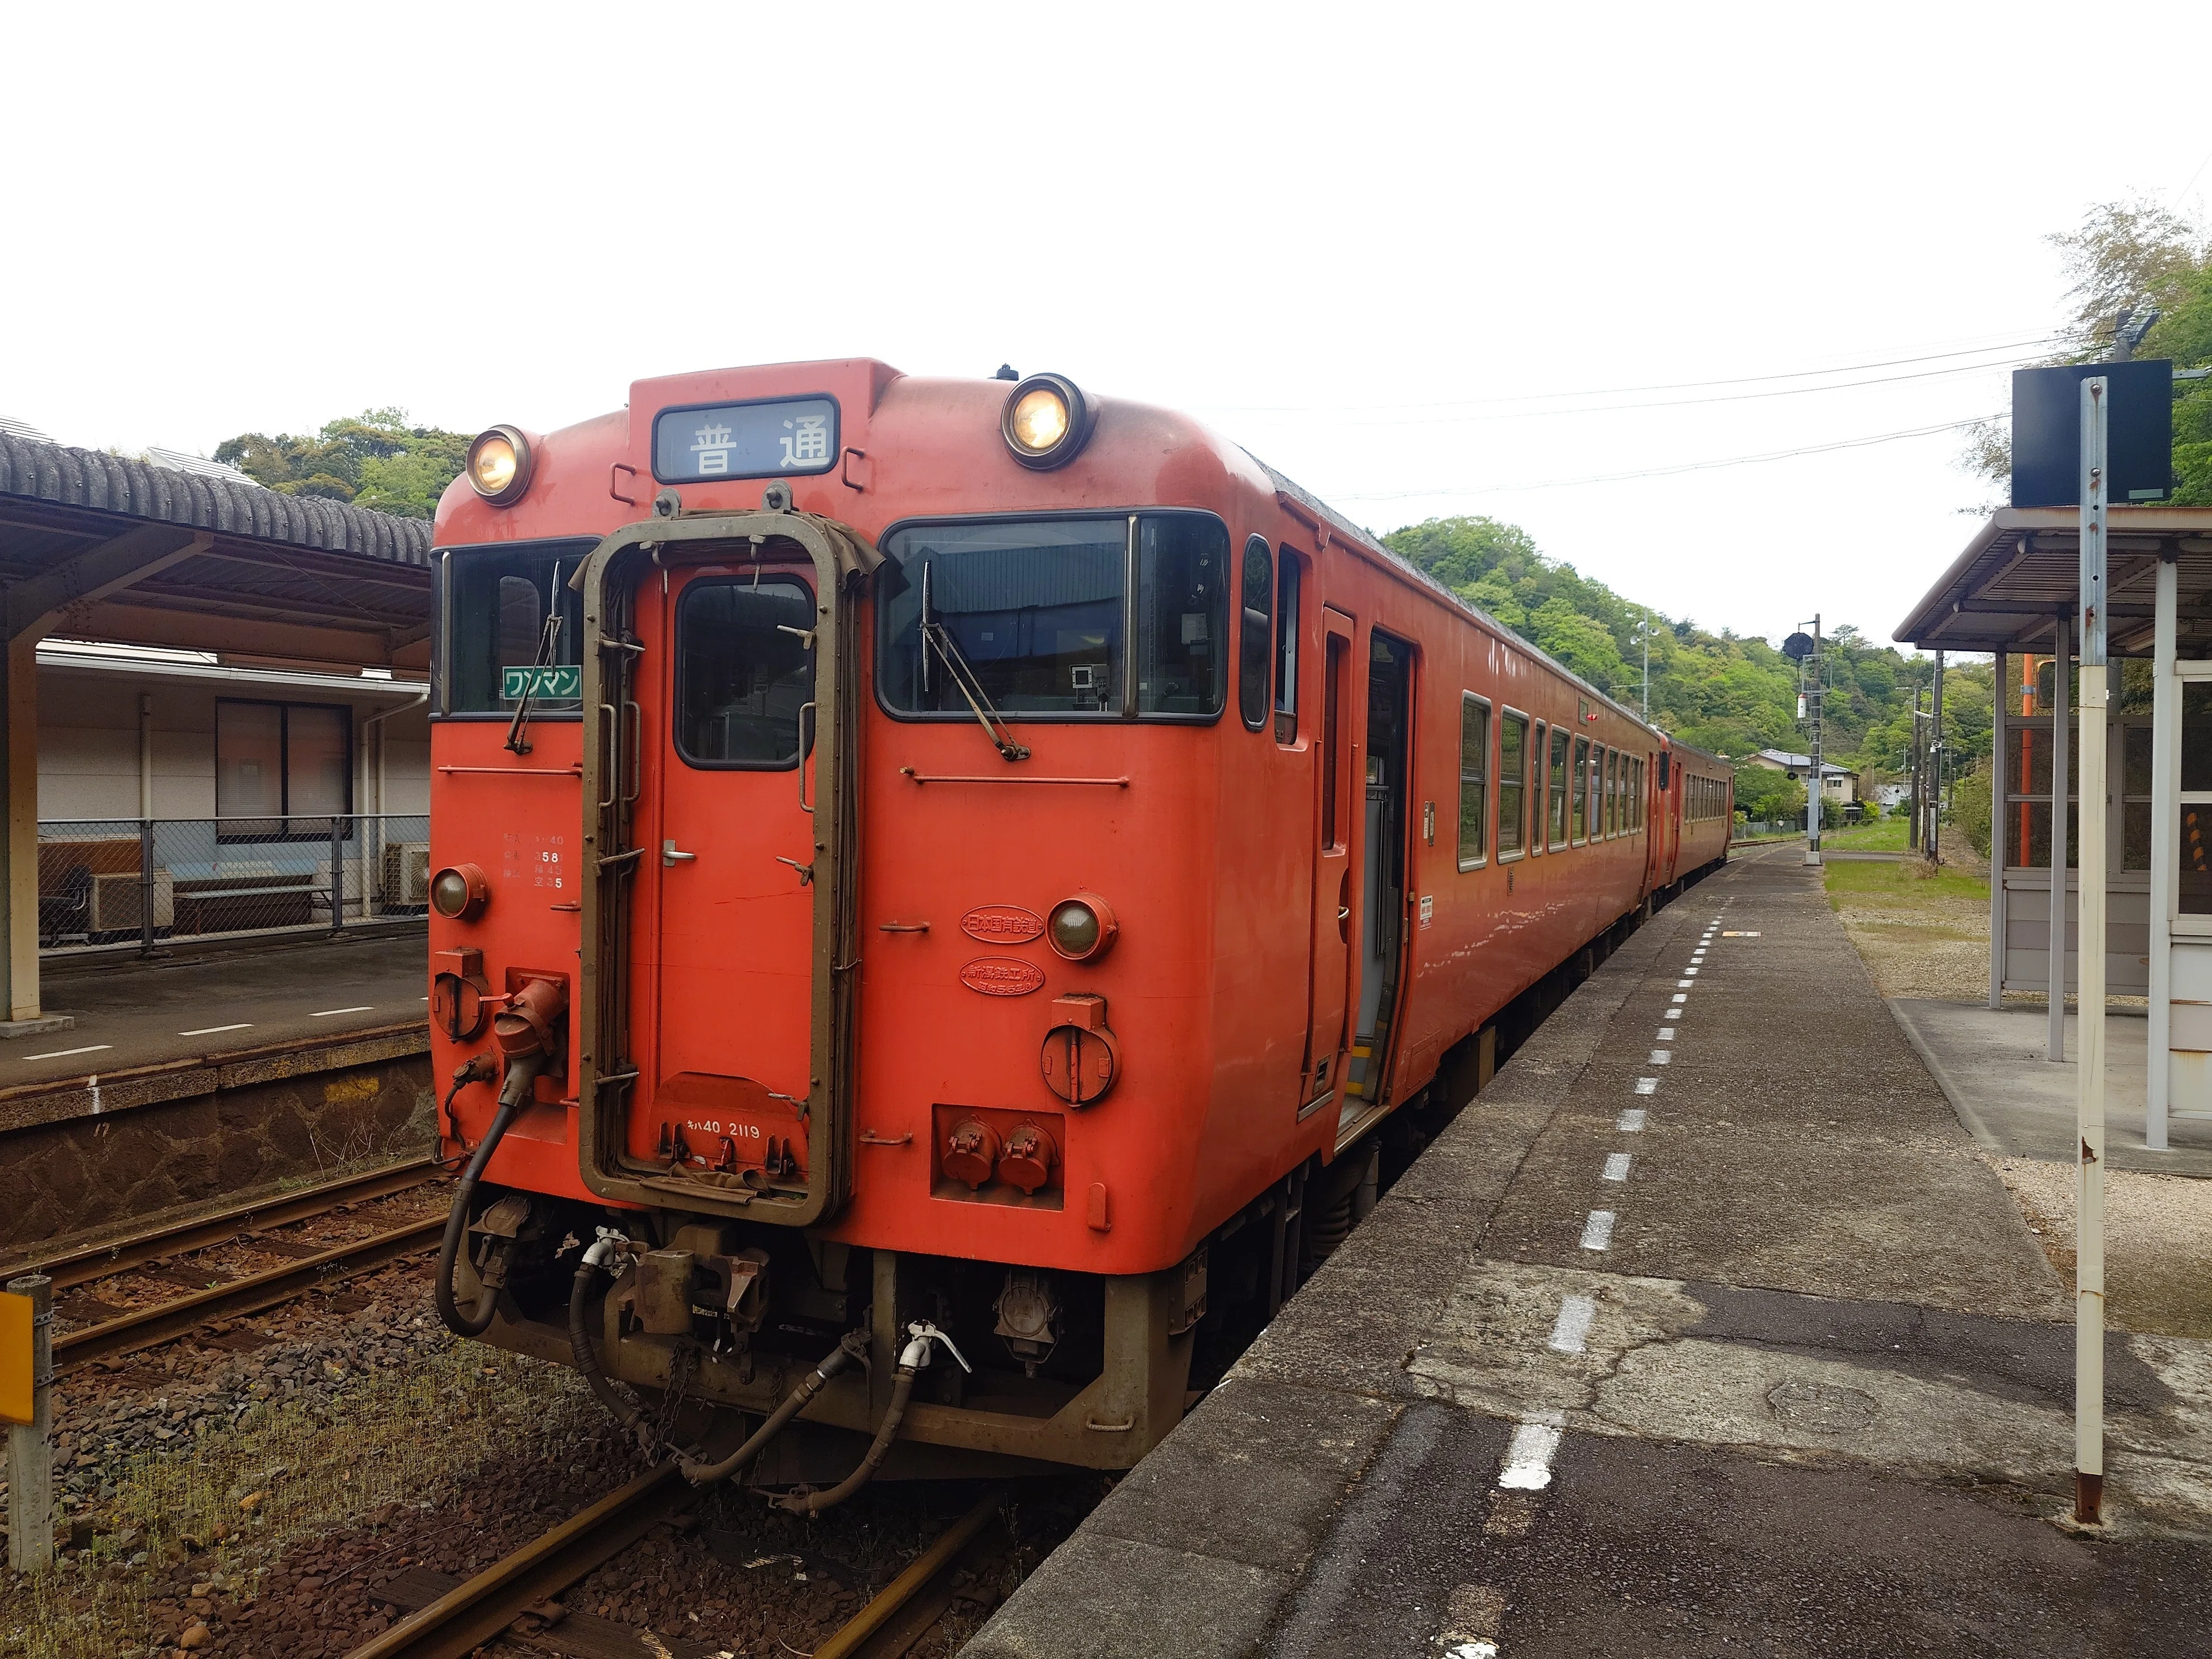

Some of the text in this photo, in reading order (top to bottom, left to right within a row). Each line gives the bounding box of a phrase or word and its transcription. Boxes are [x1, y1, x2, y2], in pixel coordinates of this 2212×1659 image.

[690, 415, 830, 474] 普通
[506, 670, 578, 695] ワンマン
[968, 914, 1037, 934] 日本国有鉄道
[687, 1119, 760, 1139] キハ40 2119
